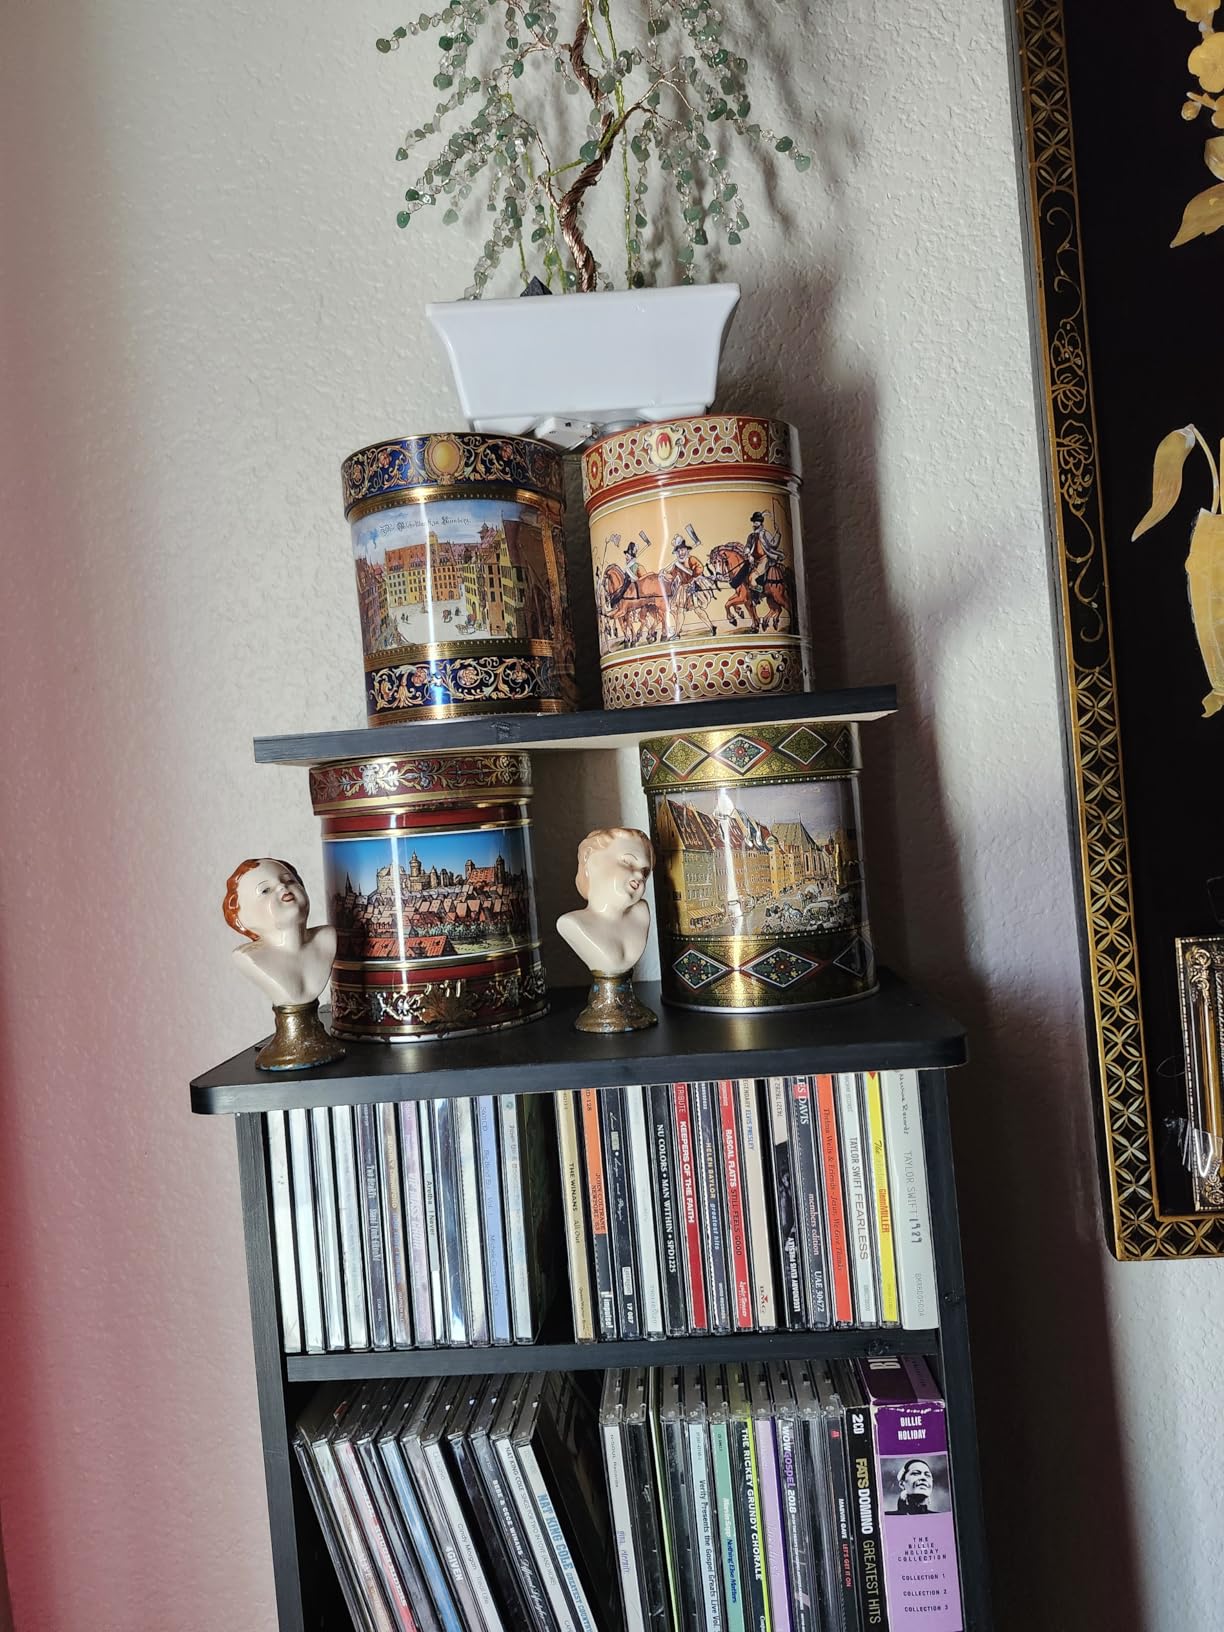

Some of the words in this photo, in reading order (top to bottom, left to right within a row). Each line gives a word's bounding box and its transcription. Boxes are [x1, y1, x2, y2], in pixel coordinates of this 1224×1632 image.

[799, 1096, 808, 1124] DAVIS
[823, 1108, 831, 1134] Thelma
[656, 1125, 664, 1137] NU
[679, 1121, 690, 1161] KEEPERS
[747, 1126, 755, 1150] PRESLEY
[658, 1138, 668, 1172] COLORS
[705, 1143, 714, 1167] HELEN
[725, 1129, 734, 1159] RASCAL
[825, 1136, 833, 1154] Wells
[849, 1137, 859, 1163] TAYLOR
[568, 1163, 576, 1178] THE
[683, 1164, 691, 1177] OF
[727, 1161, 737, 1187] FLATTS
[852, 1166, 861, 1189] SWIFT
[903, 1152, 916, 1184] TAYLOR
[570, 1180, 578, 1212] WINANS
[661, 1180, 670, 1198] MAN
[685, 1179, 693, 1196] THE
[707, 1170, 716, 1198] BAYLOR
[591, 1185, 599, 1218] NEWPORT
[596, 1186, 605, 1231] COLTRANE
[686, 1198, 695, 1223] FAITH
[730, 1190, 738, 1209] STILL
[808, 1194, 818, 1228] members
[906, 1186, 918, 1216] SWIFT
[664, 1200, 673, 1233] WITHIN
[733, 1211, 741, 1232] FEELS
[854, 1193, 868, 1260] FEARLESS
[735, 1235, 743, 1256] GOOD
[787, 1237, 798, 1262] PRESLEY
[812, 1229, 821, 1255] edition
[667, 1240, 676, 1273] SPD1225
[791, 1263, 799, 1278] ELVIS
[814, 1270, 823, 1288] UAE
[792, 1280, 801, 1312] LEGENDARY
[852, 1414, 865, 1434] 2CD
[900, 1416, 922, 1427] BILLIE
[898, 1429, 926, 1441] HOLIDAY
[504, 1446, 513, 1460] NAT
[508, 1459, 519, 1475] KING
[743, 1450, 753, 1487] RICKEY
[855, 1458, 870, 1488] FATS
[514, 1475, 524, 1491] COLE
[698, 1480, 707, 1499] Verity
[536, 1492, 553, 1515] NAT
[747, 1489, 757, 1530] GRUNDY
[787, 1490, 796, 1514] 2018
[838, 1499, 847, 1522] MARVIN
[858, 1489, 873, 1534] DOMINO
[492, 1479, 503, 1498] BEBE
[501, 1506, 512, 1525] CECE
[508, 1526, 523, 1555] WINANS
[544, 1515, 563, 1543] KING
[701, 1501, 711, 1532] Presents
[704, 1535, 712, 1547] the
[840, 1523, 848, 1539] GAYE
[455, 1522, 469, 1543] Cindy
[463, 1543, 478, 1570] Morgan
[554, 1542, 574, 1571] COLE
[751, 1533, 762, 1580] CHORALE
[898, 1554, 947, 1562] COLLECTION
[705, 1549, 715, 1572] Gospel
[726, 1539, 734, 1563] Nothing
[730, 1579, 738, 1603] Matters
[862, 1540, 879, 1595] GREATEST
[708, 1575, 717, 1597] Greats
[845, 1577, 852, 1587] ON
[710, 1599, 718, 1614] Live
[868, 1599, 881, 1624] HITS
[712, 1616, 720, 1628] Vol.
